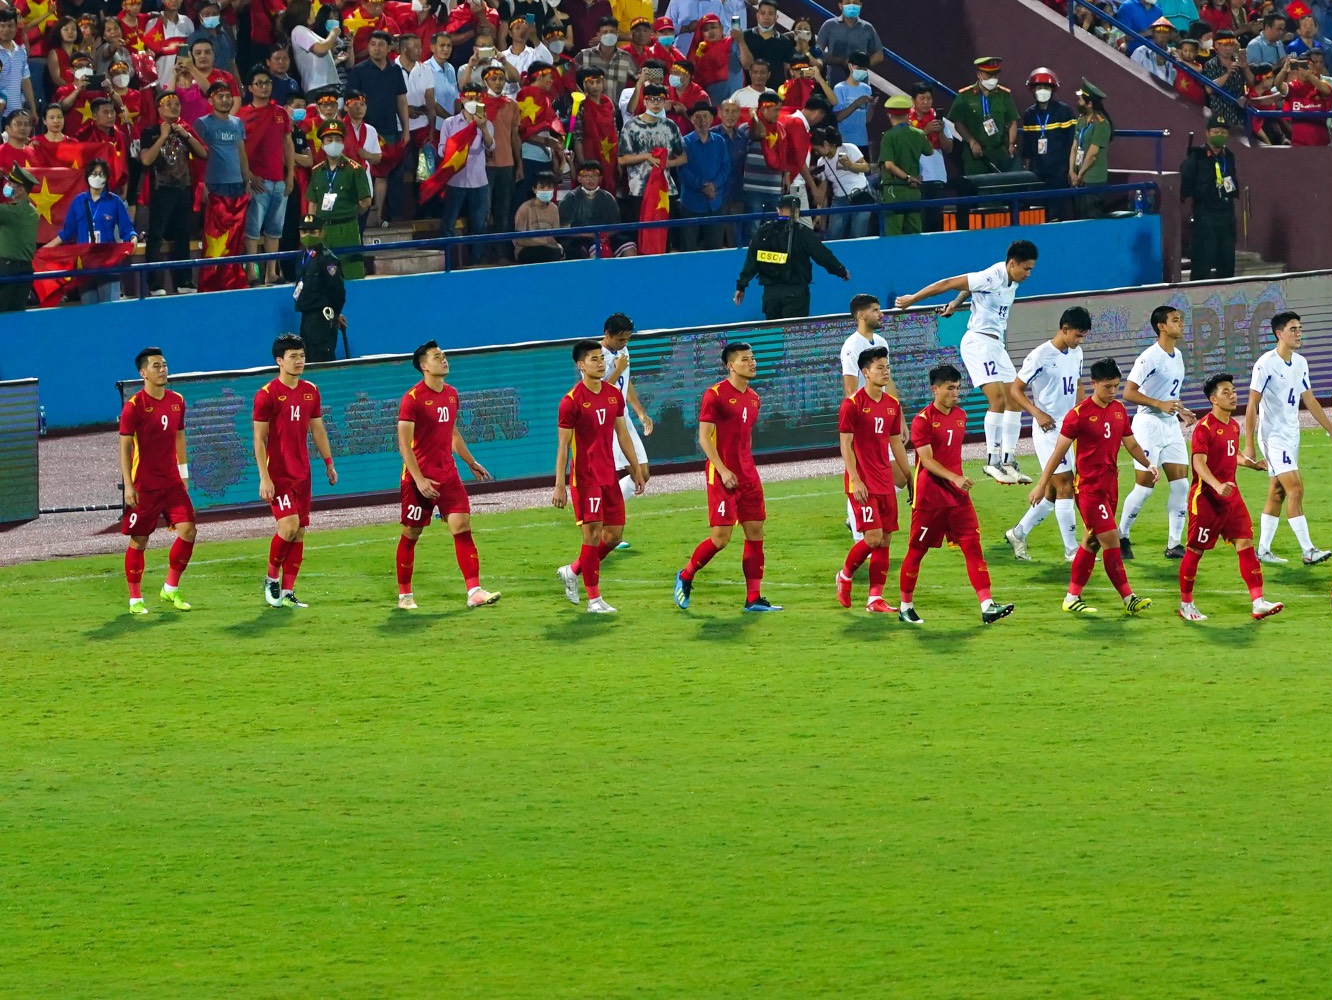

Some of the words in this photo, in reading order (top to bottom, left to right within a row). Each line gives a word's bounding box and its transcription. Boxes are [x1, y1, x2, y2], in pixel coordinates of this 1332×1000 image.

[983, 360, 998, 377] 12
[1062, 376, 1075, 395] 14
[1169, 378, 1179, 397] 2
[1287, 388, 1296, 407] 4
[290, 405, 300, 421] 14
[437, 406, 449, 422] 20
[595, 408, 606, 425] 17
[742, 407, 747, 423] 4
[161, 415, 168, 430] 9
[874, 417, 884, 434] 12
[1103, 422, 1111, 439] 3
[947, 429, 954, 446] 7
[1227, 440, 1235, 456] 15
[1282, 450, 1292, 465] 4
[276, 494, 292, 511] 14
[589, 497, 601, 513] 17
[717, 501, 726, 517] 4
[407, 505, 422, 521] 20
[861, 506, 874, 523] 12
[1098, 504, 1109, 520] 3
[129, 513, 138, 528] 9
[918, 526, 929, 542] 7
[1197, 526, 1211, 544] 15
